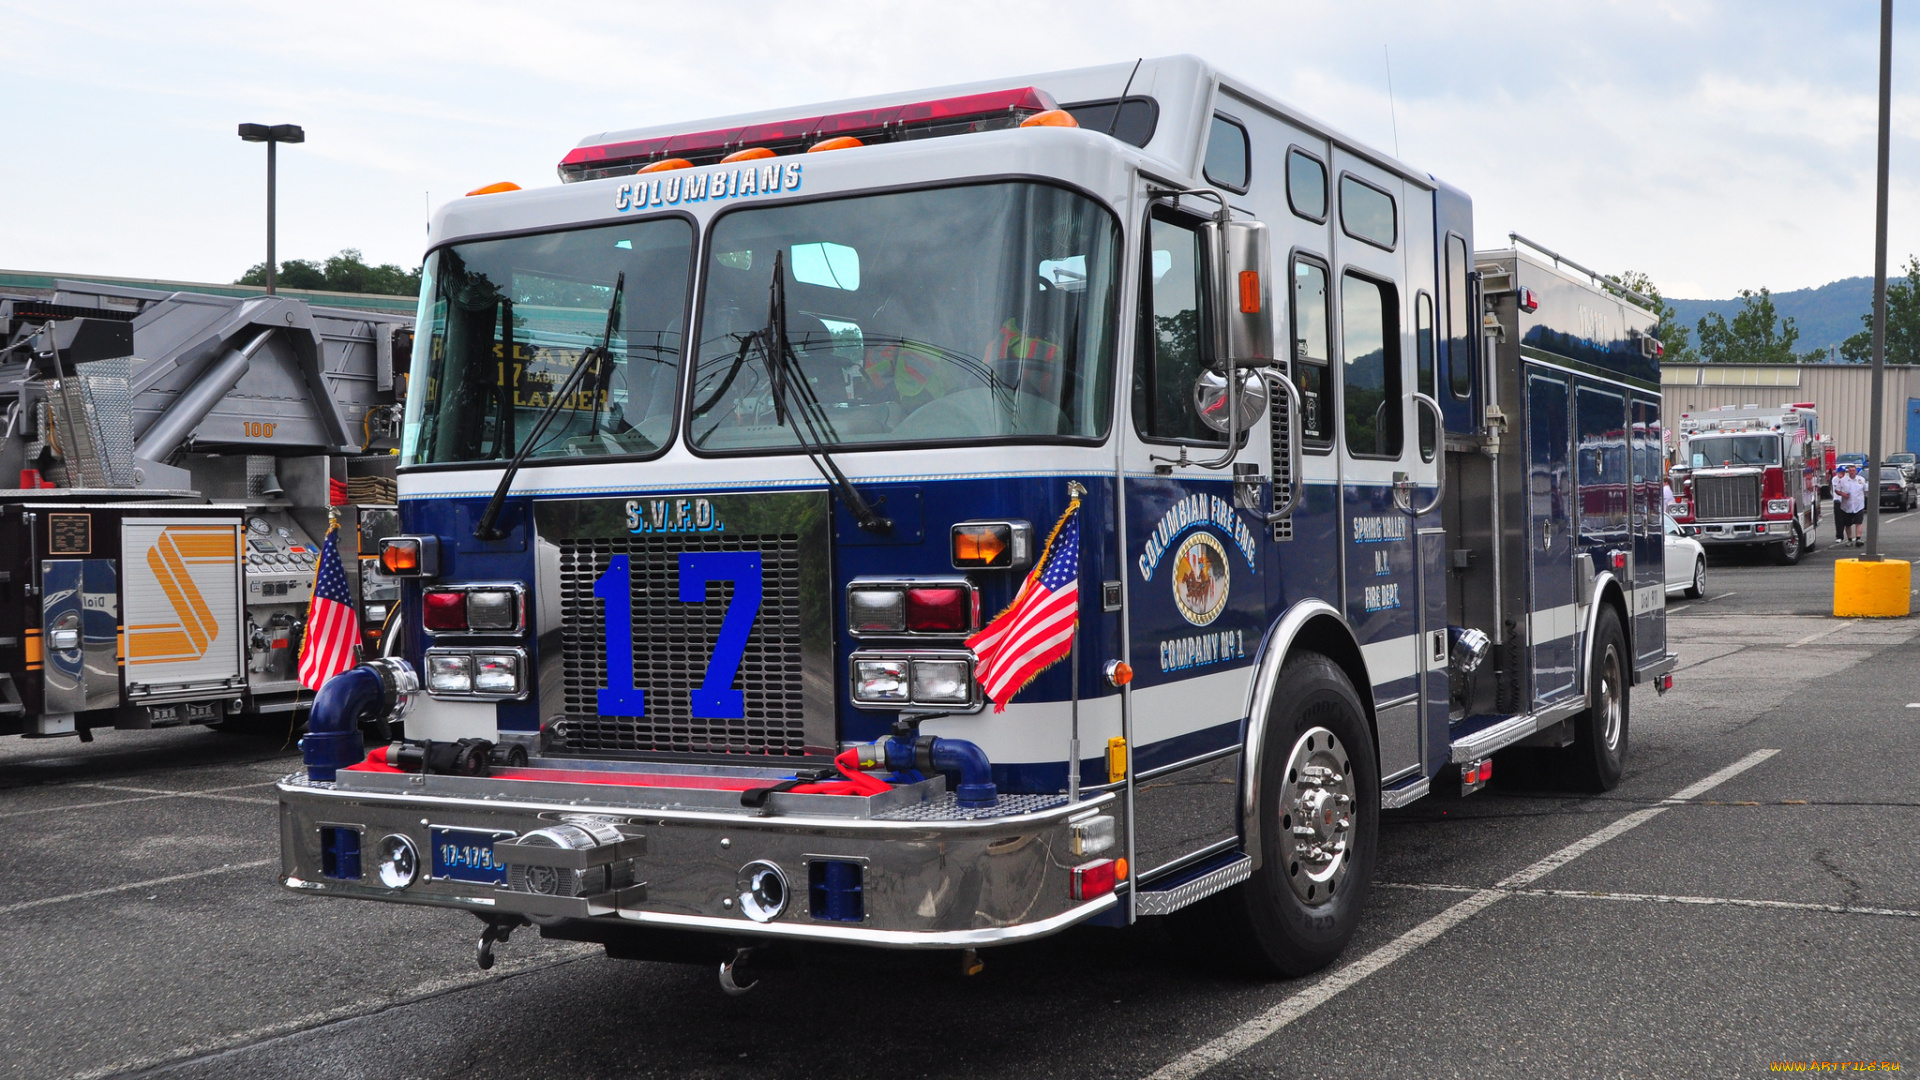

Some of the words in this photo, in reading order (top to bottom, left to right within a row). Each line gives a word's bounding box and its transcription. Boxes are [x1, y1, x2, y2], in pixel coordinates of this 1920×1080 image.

[615, 162, 803, 211] COLUMBIANS
[626, 498, 724, 533] S.V.F.D.
[1354, 517, 1382, 543] SPRING
[1382, 517, 1406, 541] VALLEY
[1139, 493, 1209, 582] COLUMBIAN
[1211, 495, 1235, 538] FIRE
[1365, 586, 1381, 612] FIRE
[594, 551, 762, 718] 17
[1160, 633, 1219, 672] COMPANY
[1237, 629, 1245, 658] 1
